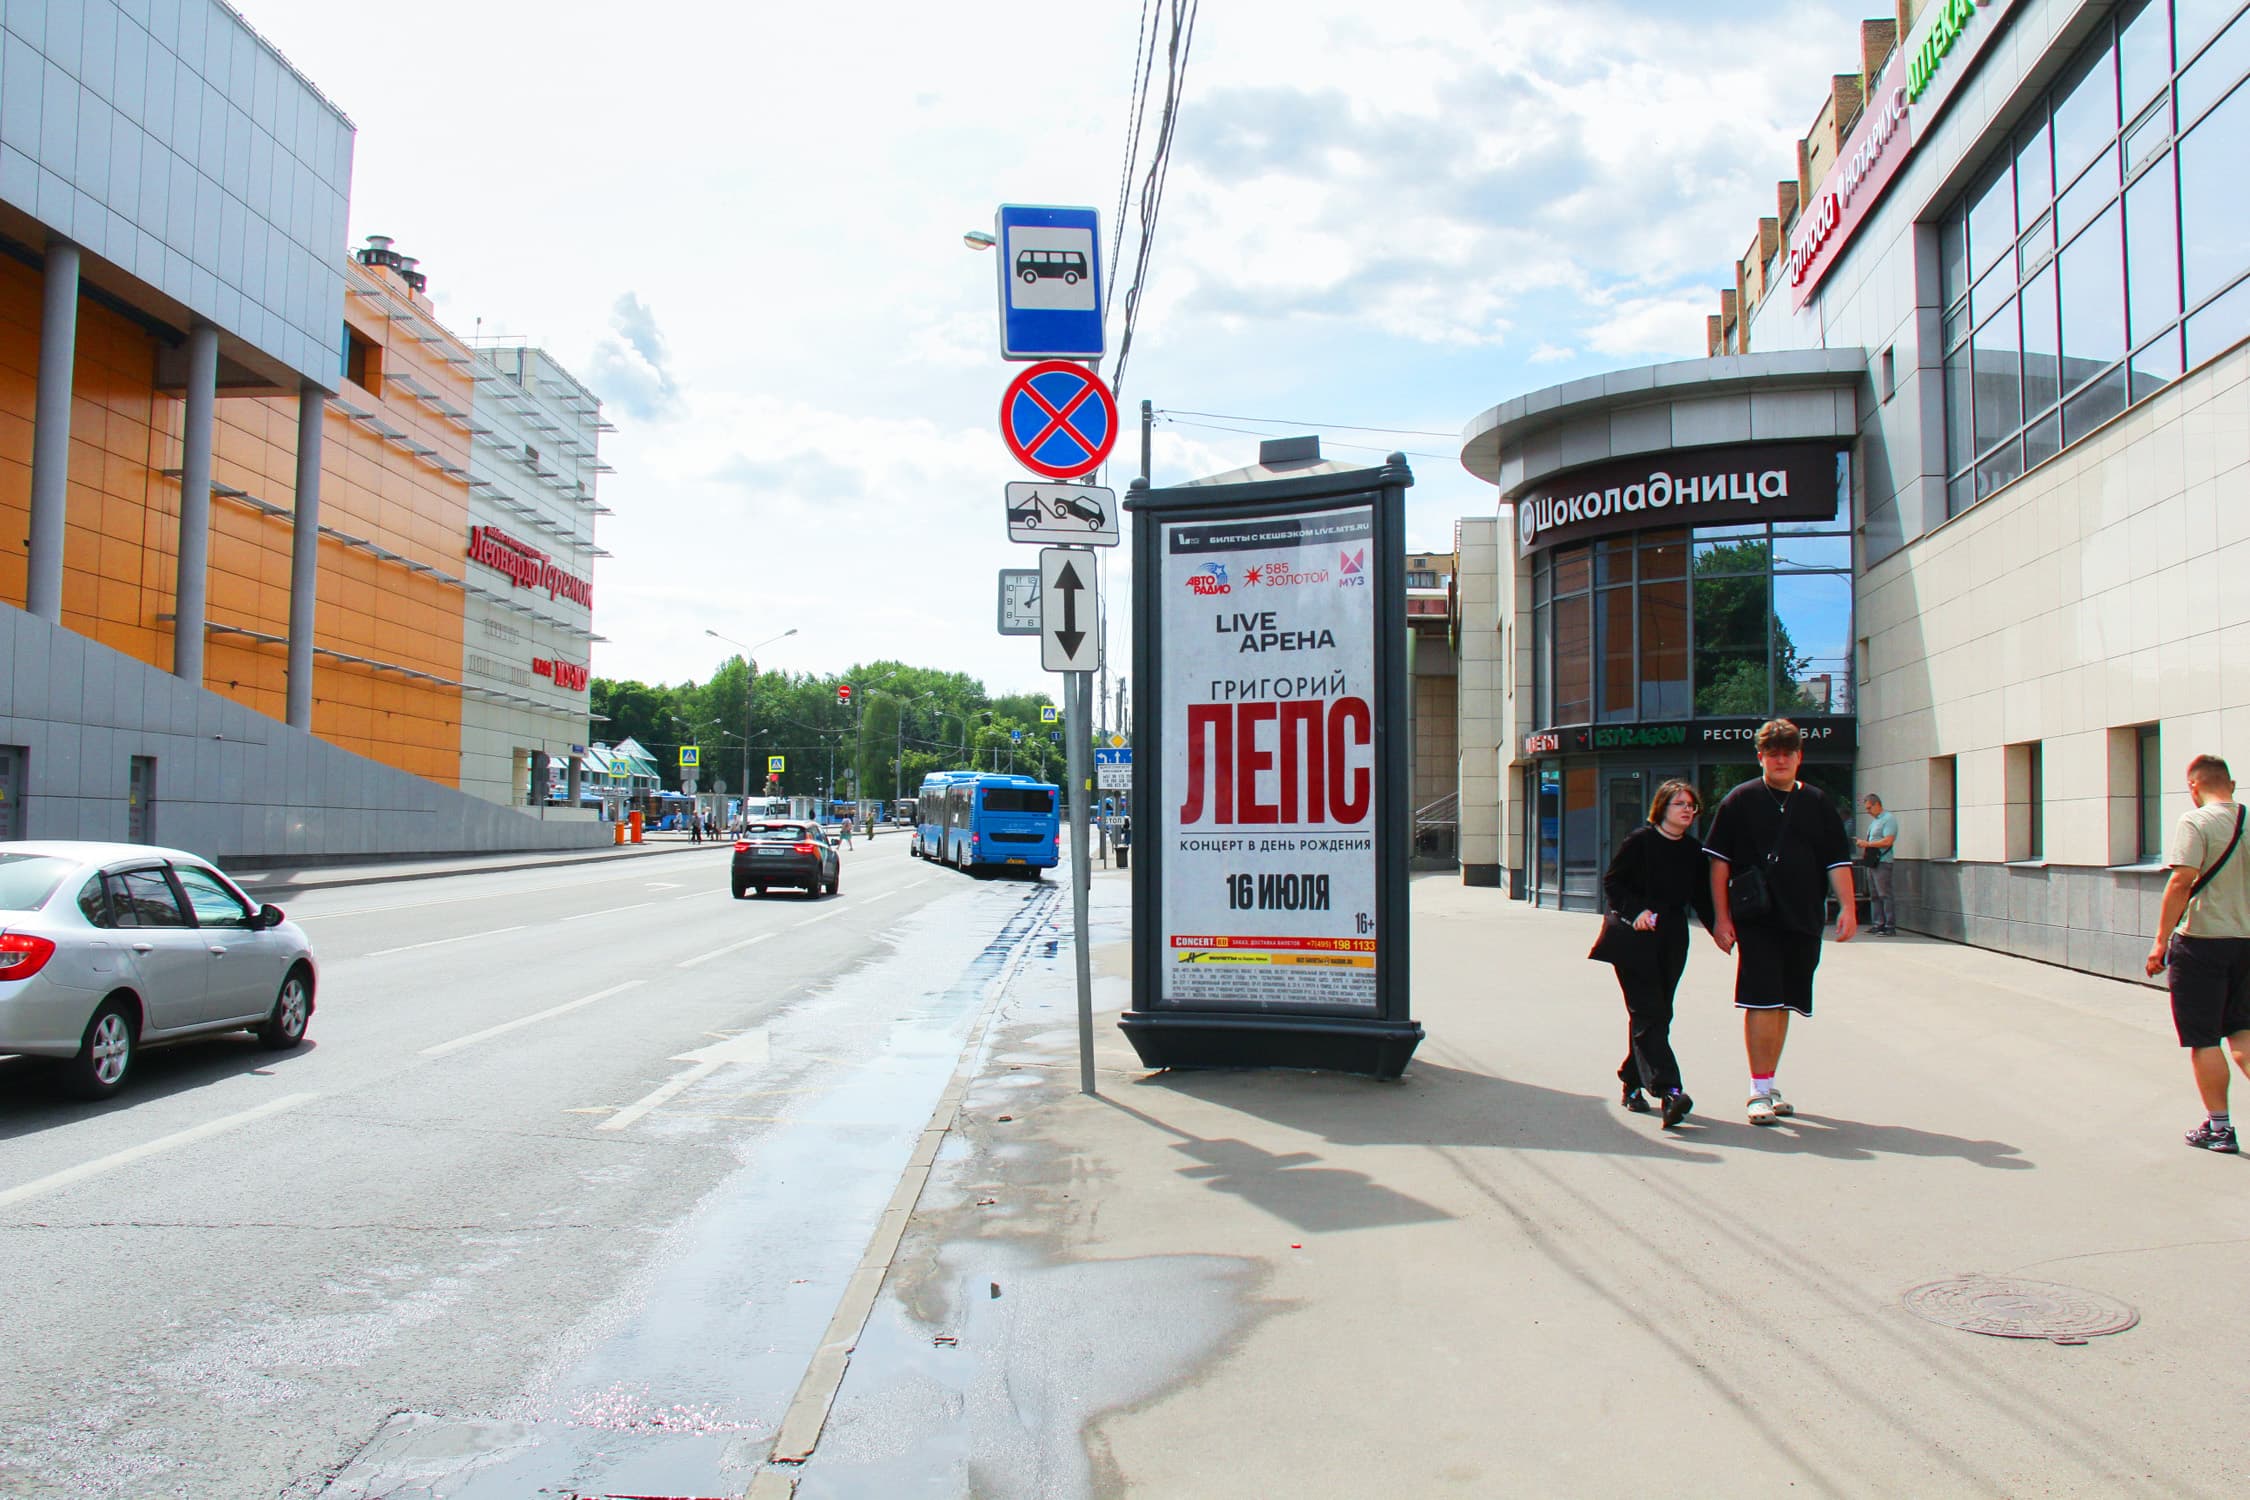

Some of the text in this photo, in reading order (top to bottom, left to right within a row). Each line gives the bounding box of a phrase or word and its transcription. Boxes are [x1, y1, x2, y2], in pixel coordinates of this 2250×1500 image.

[1907, 0, 1975, 104] АПТЕКА
[1845, 86, 1908, 196] НОТАРИУС
[1790, 193, 1840, 287] lamoda
[1535, 468, 1789, 533] Шоколадница
[1209, 535, 1250, 544] БИЛЕТЫ
[1251, 533, 1258, 541] С
[1259, 529, 1313, 540] КЕШБЭКОМ
[1314, 523, 1370, 536] LIVE.MTS.RU
[468, 525, 540, 589] Леонардо
[1265, 563, 1289, 574] 585
[1266, 569, 1328, 586] ЗОЛОТОЙ
[539, 560, 593, 611] Теремок
[1185, 575, 1215, 586] АВТО
[1194, 585, 1231, 595] РАДИО
[1339, 576, 1365, 588] МУЗ
[1216, 612, 1277, 633] LIVE
[1239, 630, 1336, 653] АРЕНА
[1210, 669, 1346, 700] ГРИГОРИЙ
[1594, 726, 1686, 747] ESTRAGON
[1703, 727, 1832, 740] РЕСТО БАР
[1180, 697, 1371, 825] ЛЕПС
[1180, 839, 1371, 852] КОНЦЕРТ В ДЕНЬ РОЖДЕНИЯ
[1226, 873, 1330, 910] 16 ИЮЛЯ
[1355, 912, 1375, 934] 16+
[1332, 939, 1351, 951] 198
[1353, 941, 1375, 952] 1133
